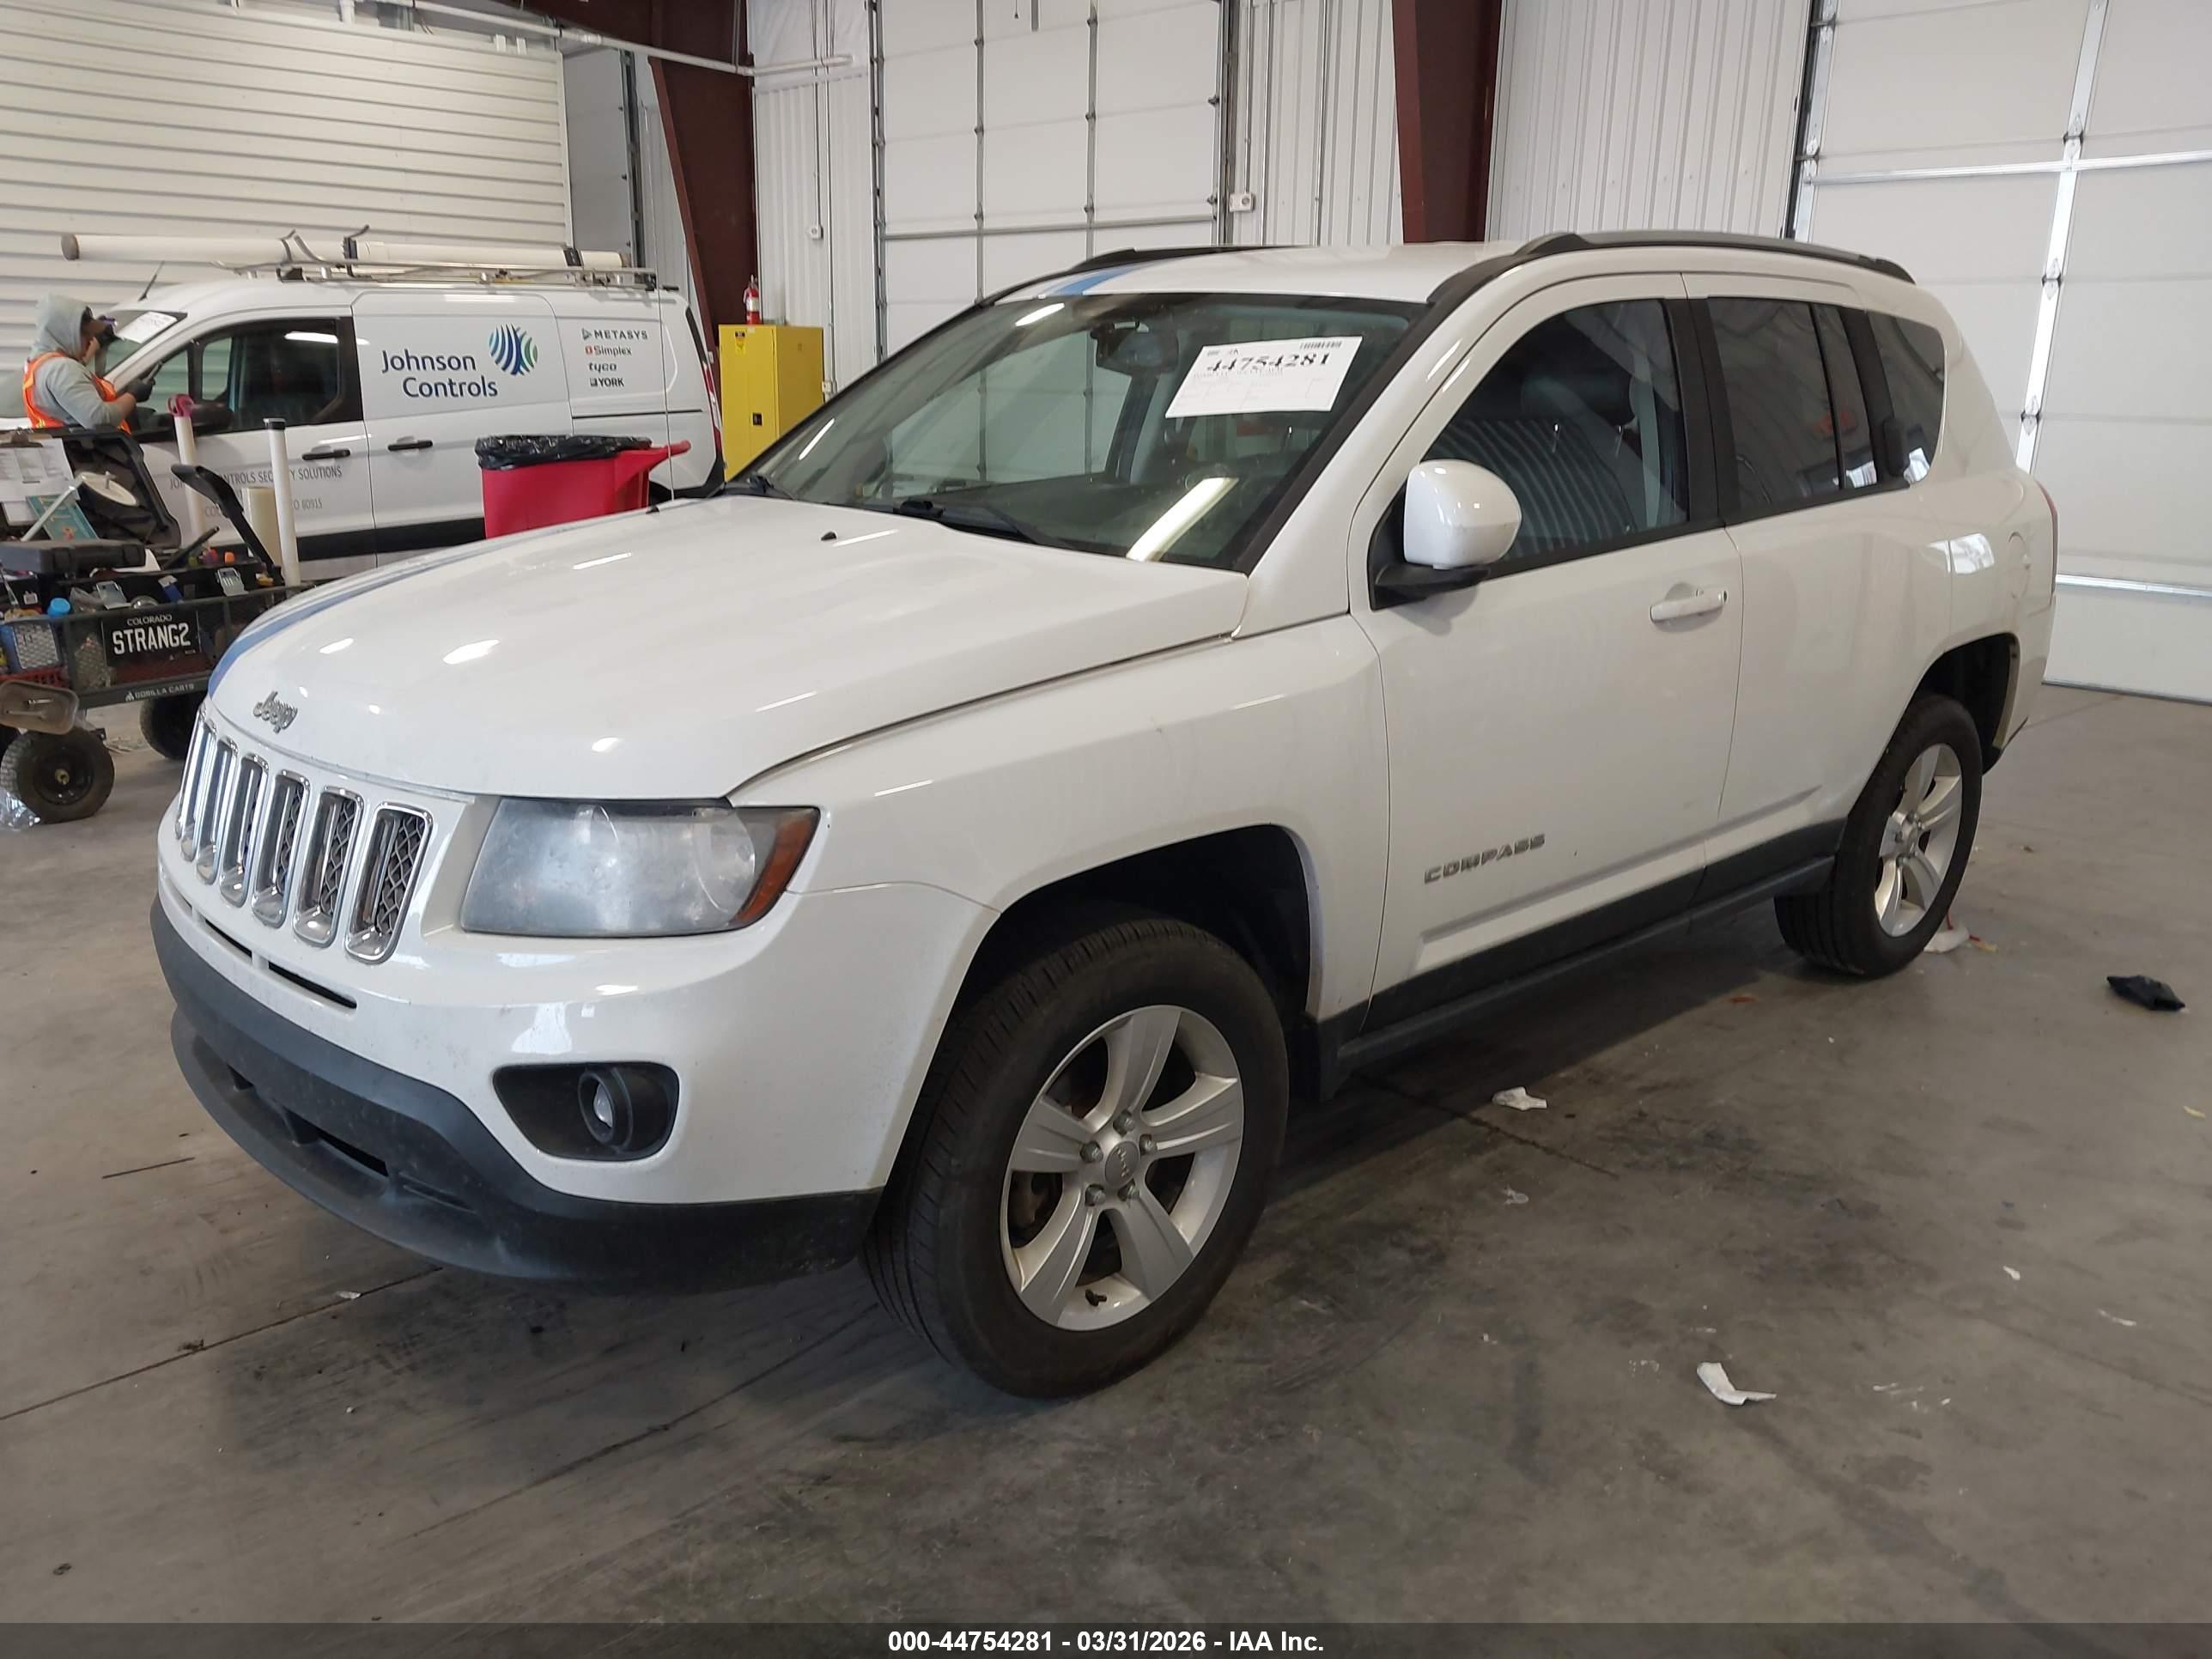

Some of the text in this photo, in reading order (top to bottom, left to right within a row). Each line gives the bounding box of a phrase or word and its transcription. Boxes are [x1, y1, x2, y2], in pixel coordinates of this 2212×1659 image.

[593, 329, 647, 340] METASYS
[593, 345, 632, 357] Simplex
[381, 348, 477, 374] Johnson
[1206, 352, 1329, 371] 44754281
[402, 374, 499, 398] Controls
[598, 378, 624, 387] YORK
[298, 465, 343, 480] SOLUTIONS
[127, 614, 173, 626] COLORADO
[112, 623, 191, 654] STRANG2
[135, 684, 194, 699] GORILLA CARTS
[1424, 833, 1546, 884] COMPASS
